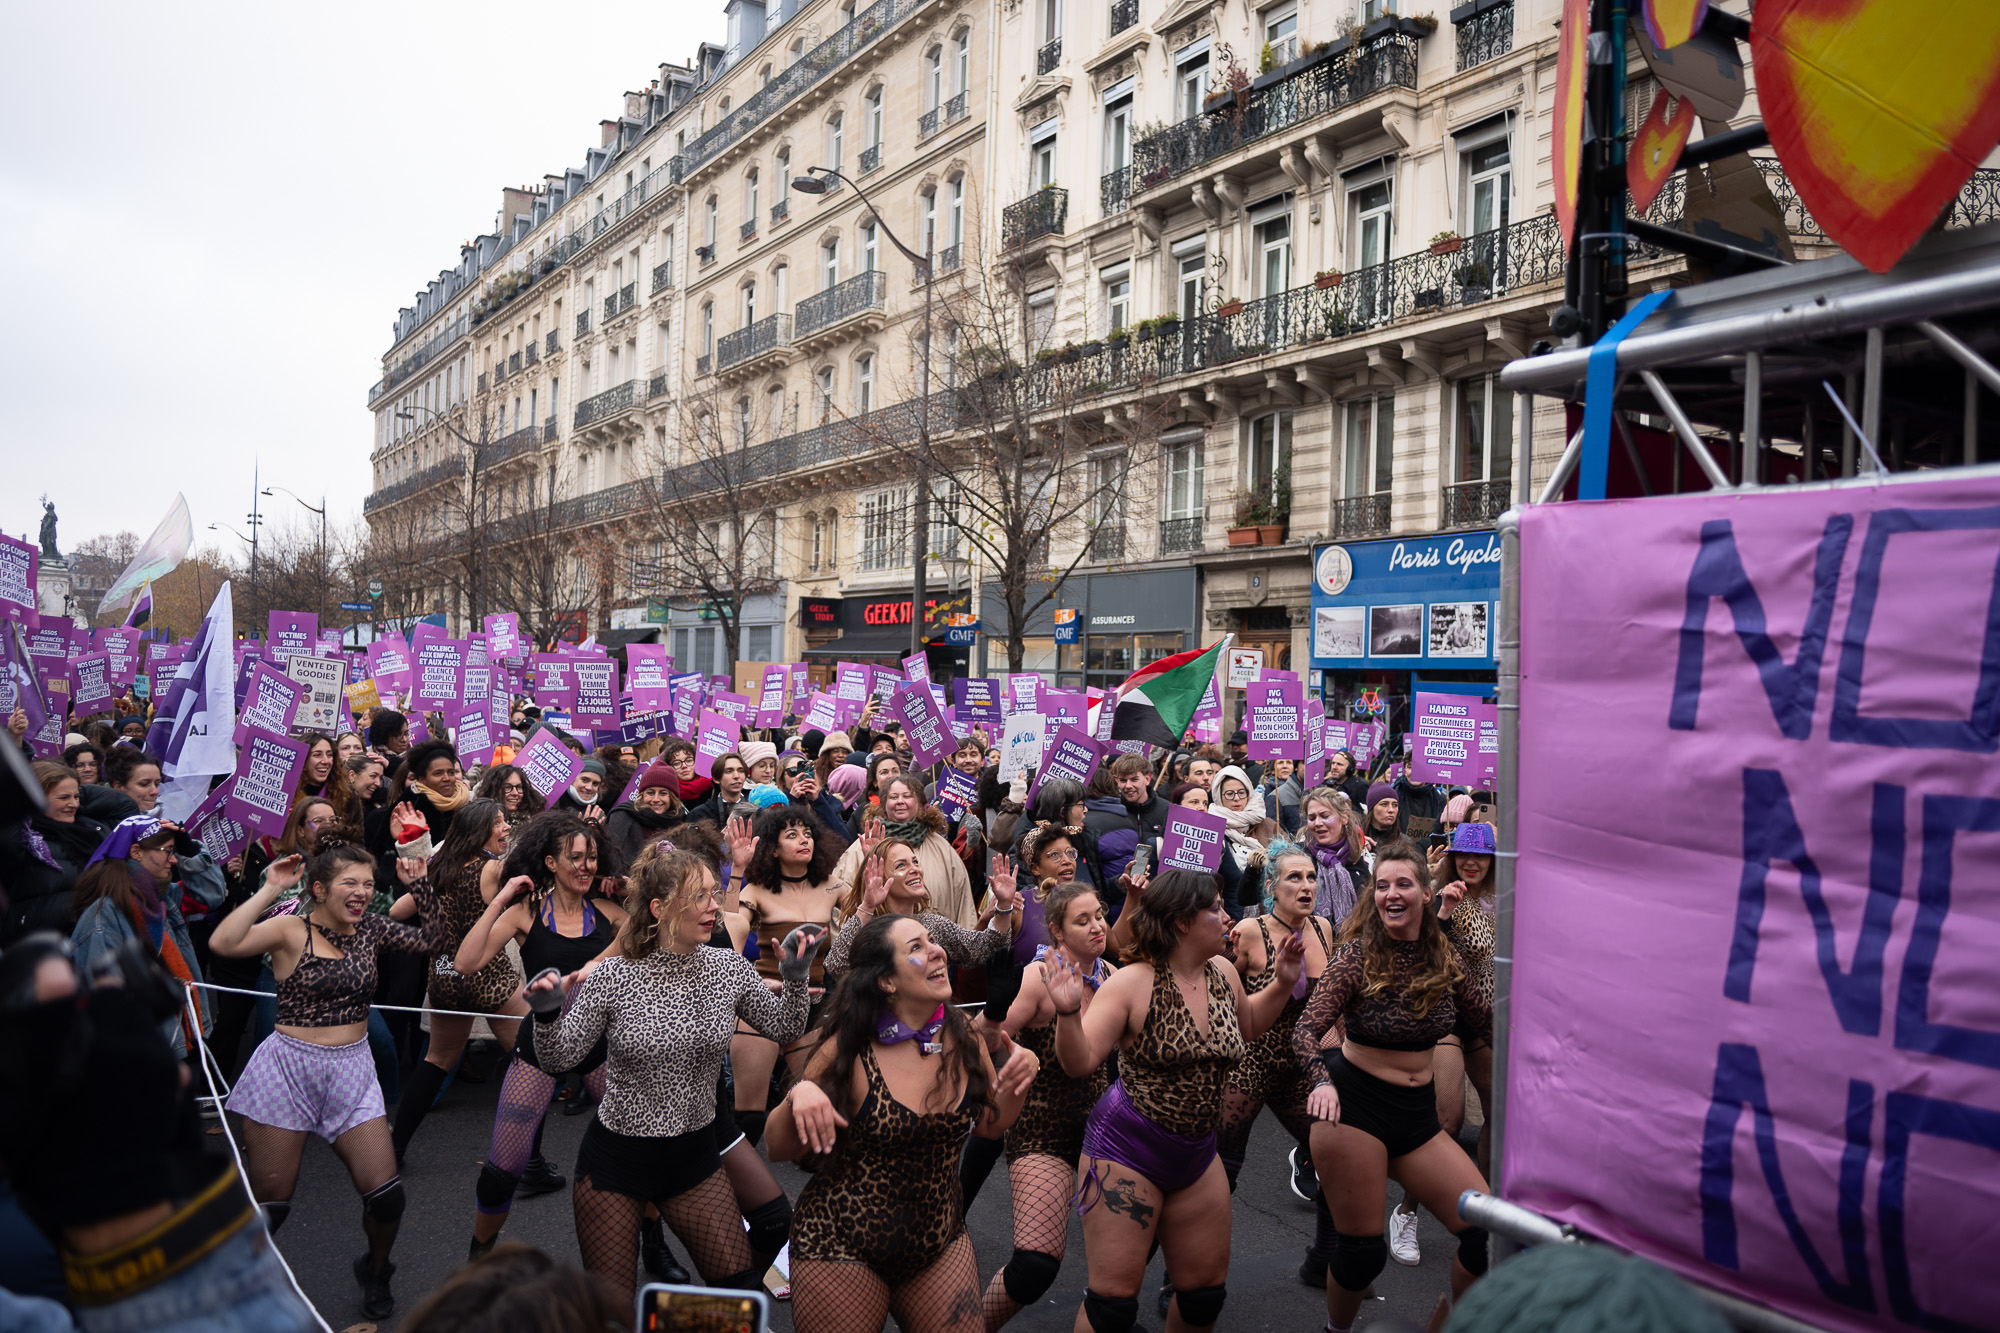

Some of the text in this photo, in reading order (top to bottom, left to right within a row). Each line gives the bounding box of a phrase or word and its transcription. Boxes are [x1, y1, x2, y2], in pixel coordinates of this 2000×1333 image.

[10, 547, 30, 559] CORPS
[1389, 535, 1501, 574] Paris Cycle
[3, 554, 30, 569] LA TERRE
[12, 565, 25, 576] SONT
[3, 572, 25, 585] PAS DES
[3, 590, 33, 606] CONQUÊTE
[864, 603, 899, 624] GEEK
[1092, 616, 1135, 624] ASSURANCES
[950, 629, 974, 641] GMF
[1056, 628, 1073, 639] GMF
[272, 647, 311, 655] CONNAISSENT
[87, 658, 104, 667] CORPS
[91, 665, 105, 673] TERRE
[296, 660, 324, 669] VENTE
[297, 669, 335, 680] GOODIES
[77, 685, 108, 695] TERRITOIRES
[261, 674, 294, 698] NOS CORPS
[259, 683, 292, 707] & LA TERRE
[905, 692, 914, 701] LES
[260, 694, 286, 712] NE SONT
[717, 701, 743, 711] CULTURE
[1429, 705, 1466, 715] HANDIES
[258, 704, 282, 721] PAS DES
[248, 708, 285, 734] TERRITOIRES
[912, 718, 937, 738] DES DROITS
[1422, 718, 1472, 727] DISCRIMINÉES
[712, 728, 727, 737] ASSOS
[922, 730, 934, 740] POUR
[1421, 728, 1473, 738] INVISIBILISÉES
[254, 738, 296, 760] NOS CORPS
[923, 735, 940, 749] TOUTES
[1431, 741, 1461, 749] PRIVÉES
[543, 741, 571, 767] VIOLENCE
[1063, 741, 1076, 753] QUI
[1075, 746, 1093, 761] SÈME
[1438, 749, 1465, 757] DROITS
[251, 749, 293, 770] & LA TERRE
[528, 749, 567, 783] ET AUX ADOS
[533, 744, 572, 776] AUX ENFANTS
[1055, 751, 1089, 773] LA MISÈRE
[253, 760, 284, 778] NE SONT
[530, 763, 554, 784] SILENCE
[251, 772, 281, 788] PAS DES
[239, 778, 286, 802] TERRITOIRES
[235, 788, 284, 813] DE CONQUÊTE
[220, 817, 234, 842] SUR 10
[1174, 823, 1216, 842] CULTURE
[204, 832, 218, 859] VIOLEUR
[1185, 839, 1198, 850] DU
[1177, 850, 1201, 864] VIOL
[1164, 858, 1212, 873] CONSENTEMENT
